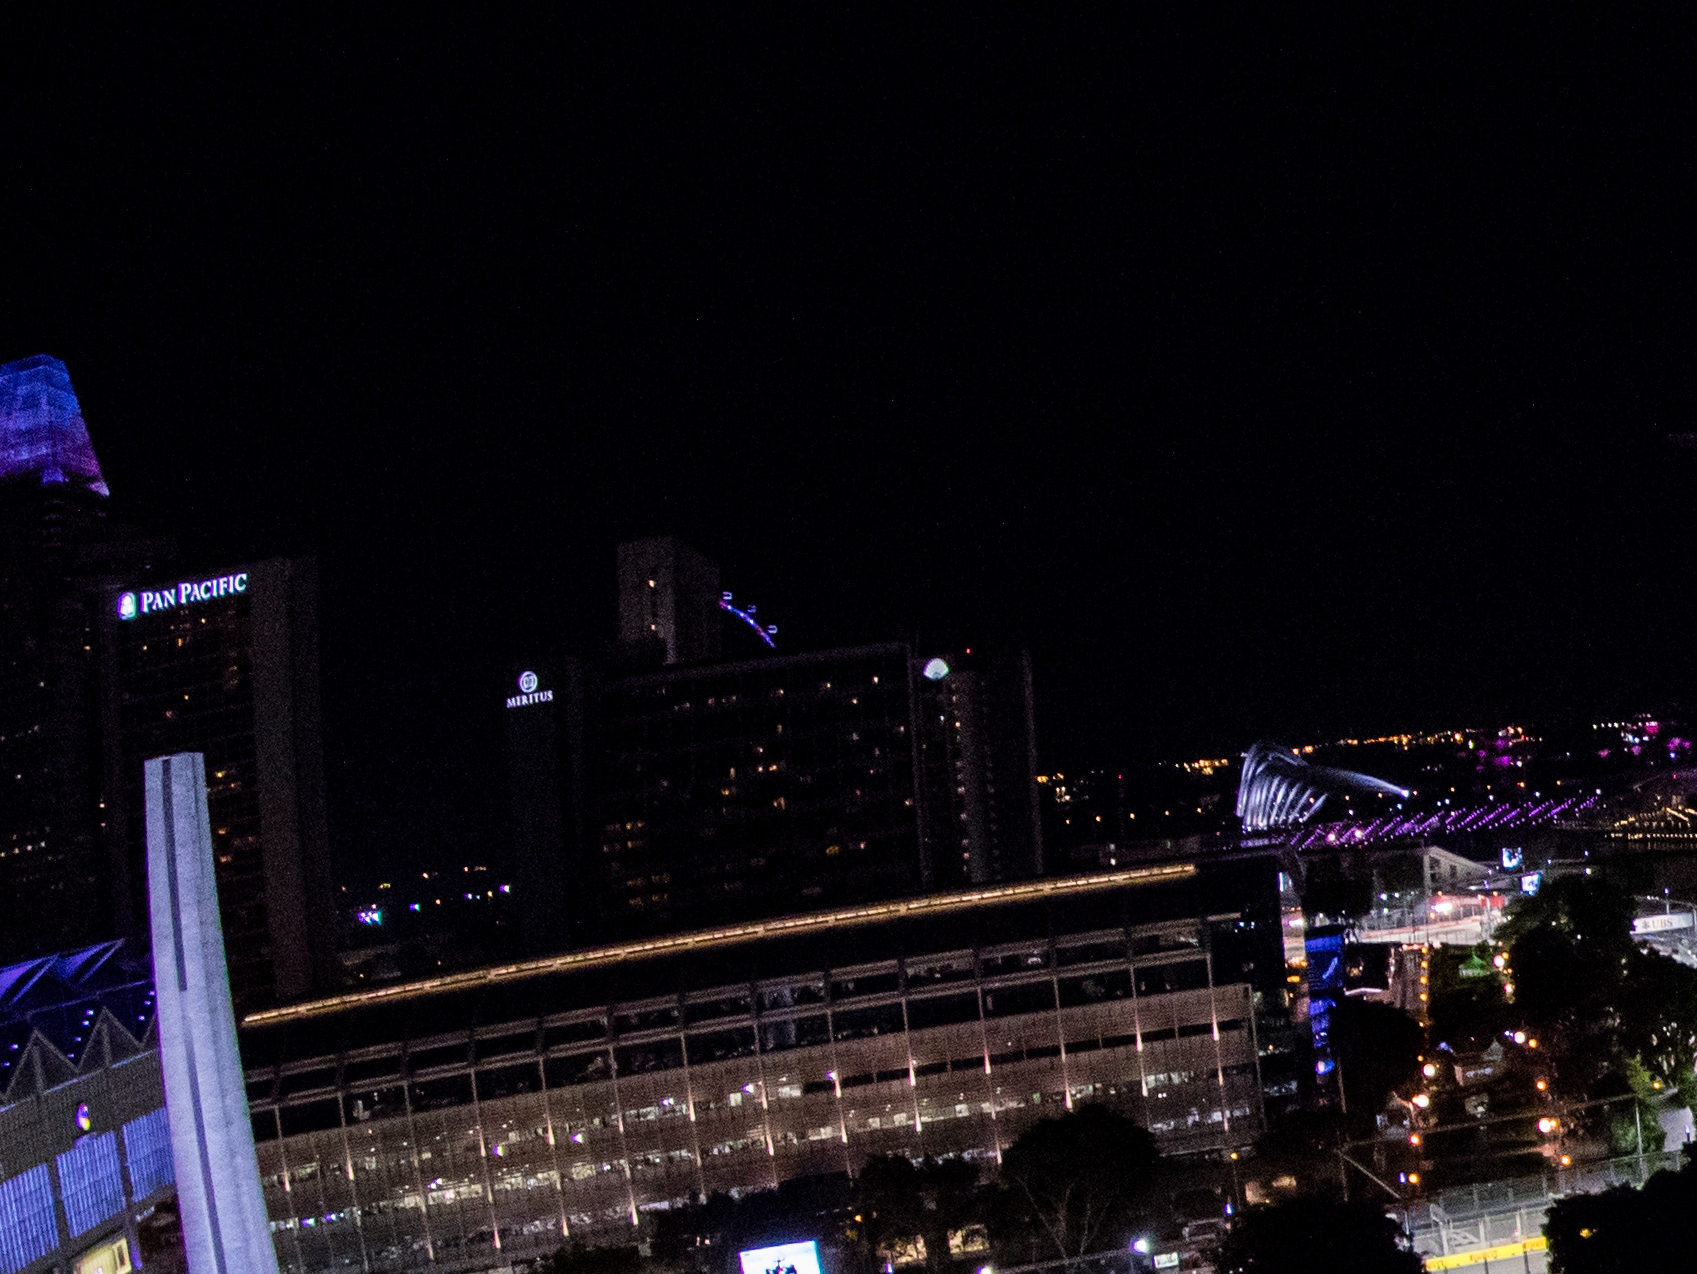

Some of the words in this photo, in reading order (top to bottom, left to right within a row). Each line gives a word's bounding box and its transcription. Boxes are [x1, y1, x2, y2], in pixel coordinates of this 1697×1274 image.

[140, 588, 177, 613] PAN
[177, 572, 248, 604] PACIFIC
[506, 690, 553, 709] MERITUS
